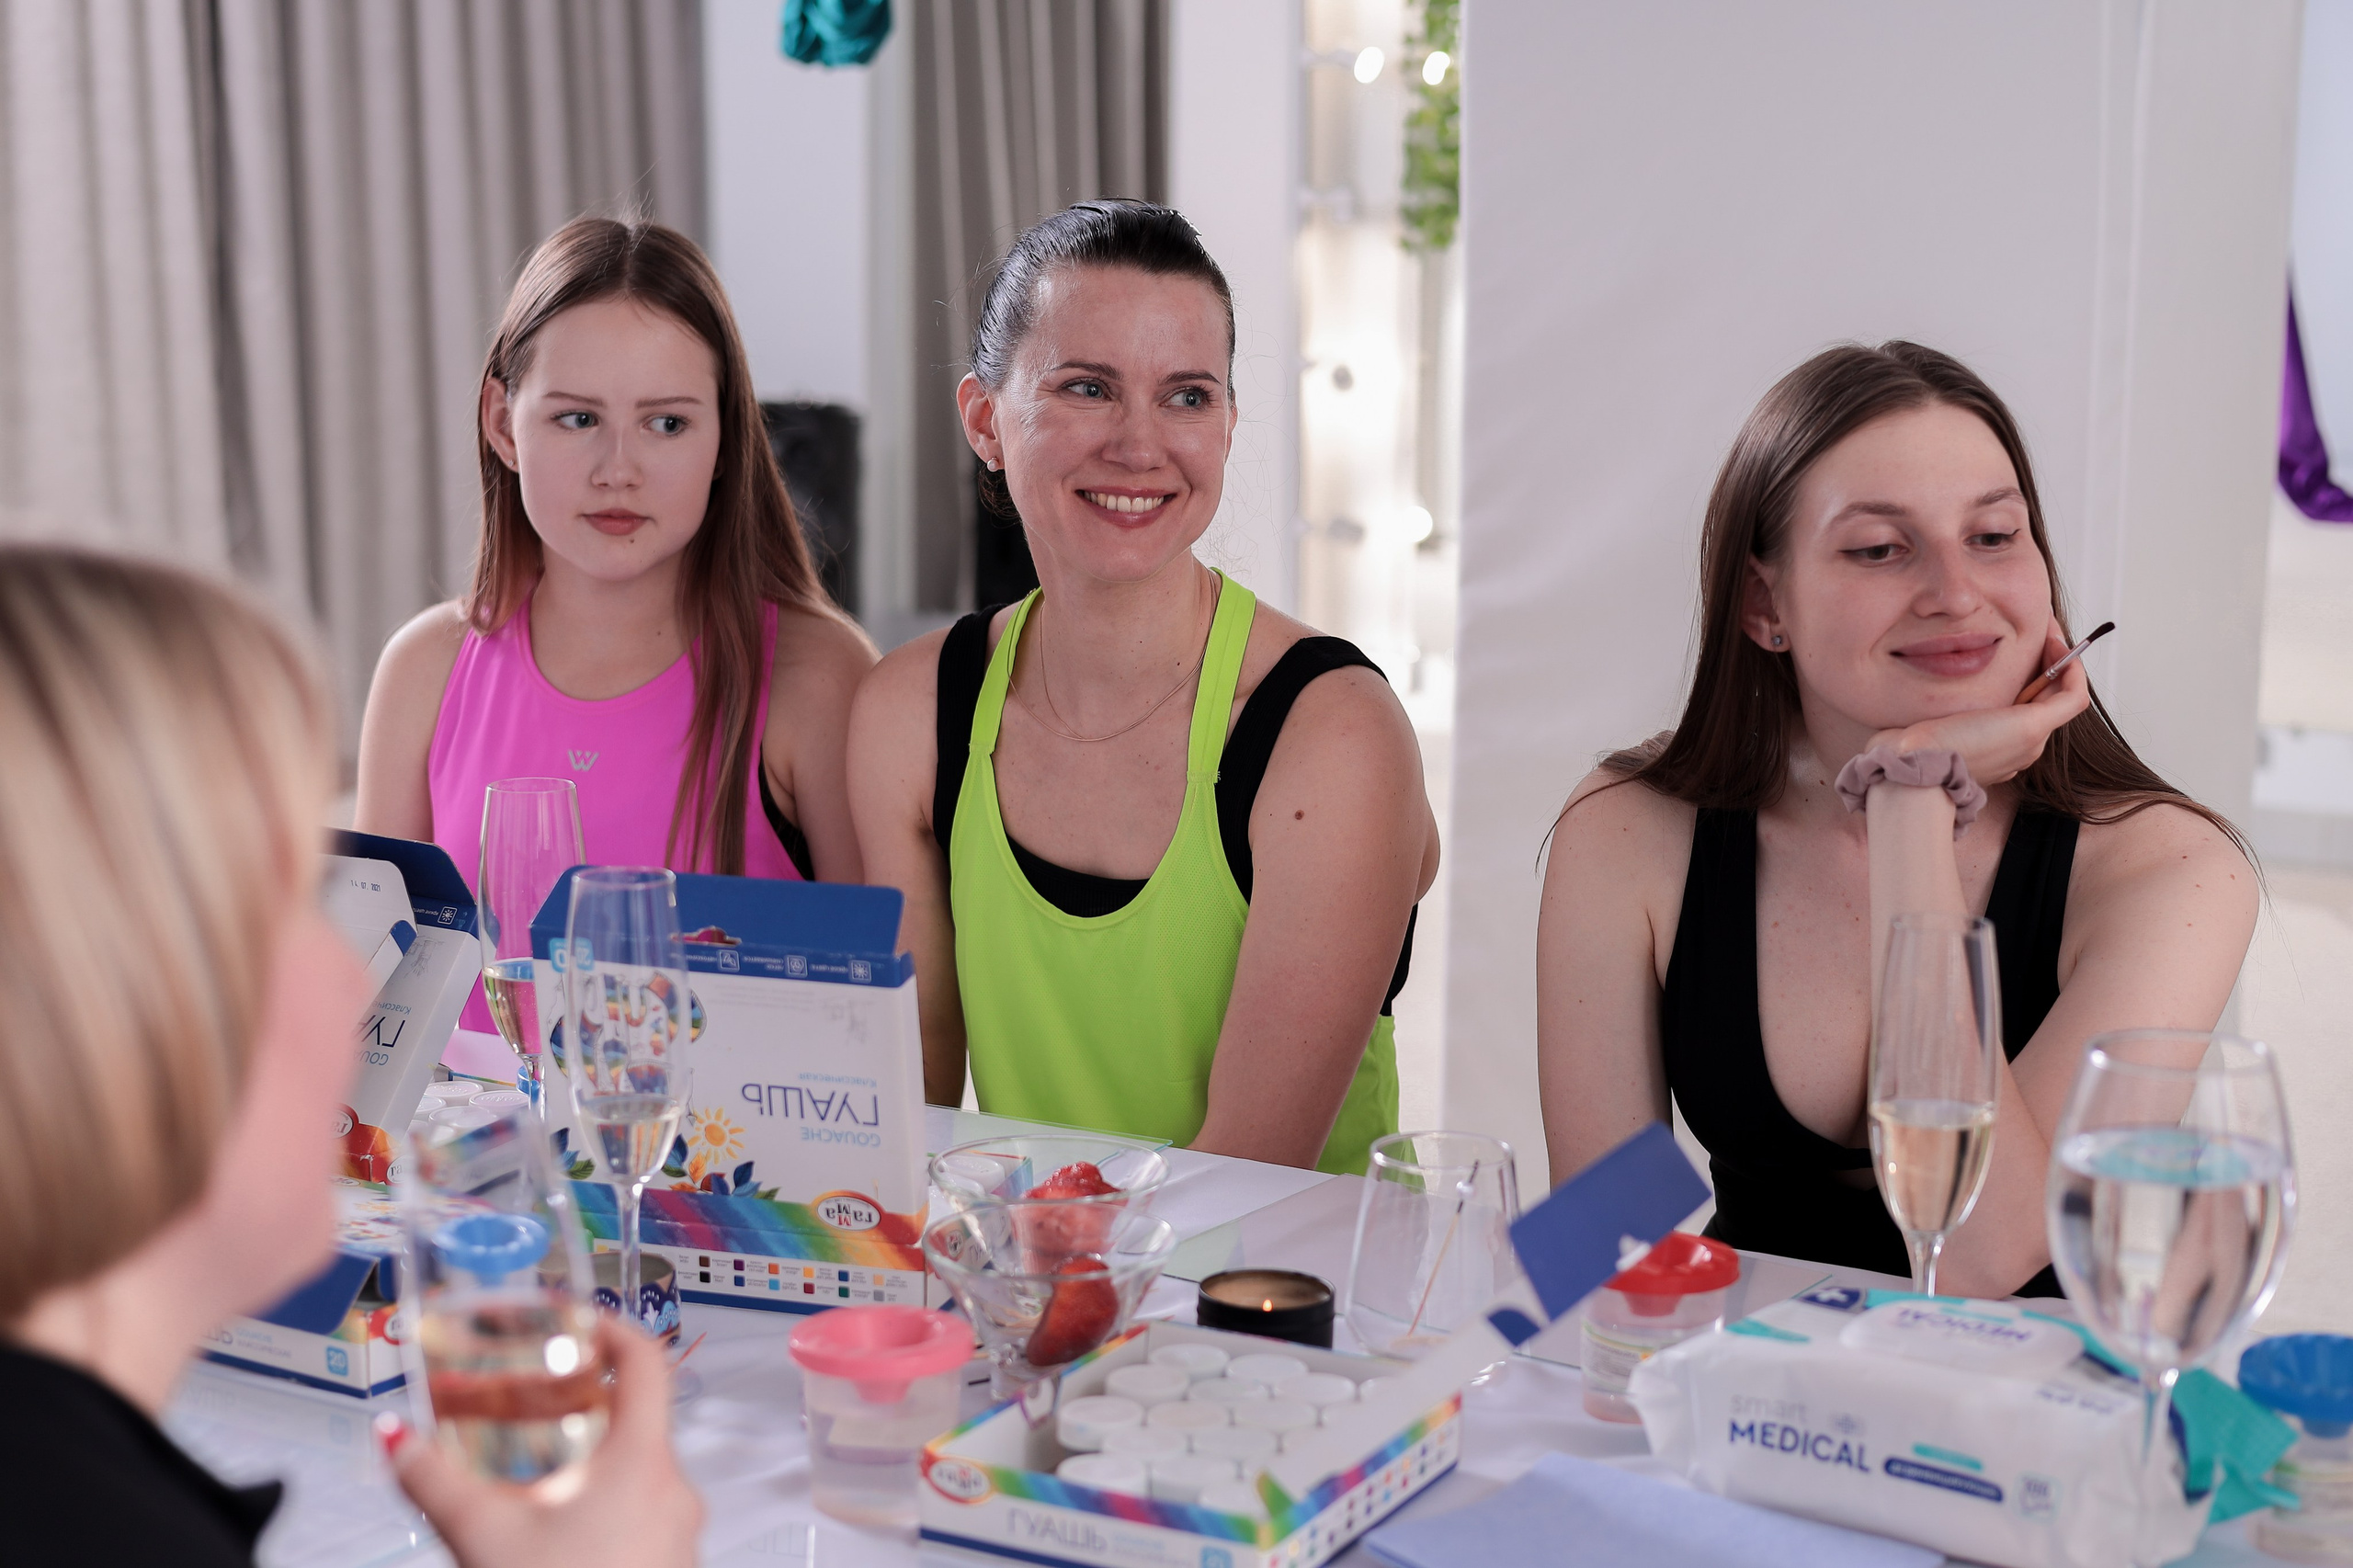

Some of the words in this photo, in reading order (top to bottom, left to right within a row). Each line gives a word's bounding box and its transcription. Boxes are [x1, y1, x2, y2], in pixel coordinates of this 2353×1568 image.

[741, 1083, 881, 1127] ГУАШЬ
[800, 1126, 881, 1148] GOUACHE
[1730, 1393, 1807, 1424] smart
[1728, 1417, 1872, 1473] MEDICAL
[1006, 1507, 1108, 1553] ГУАШЬ
